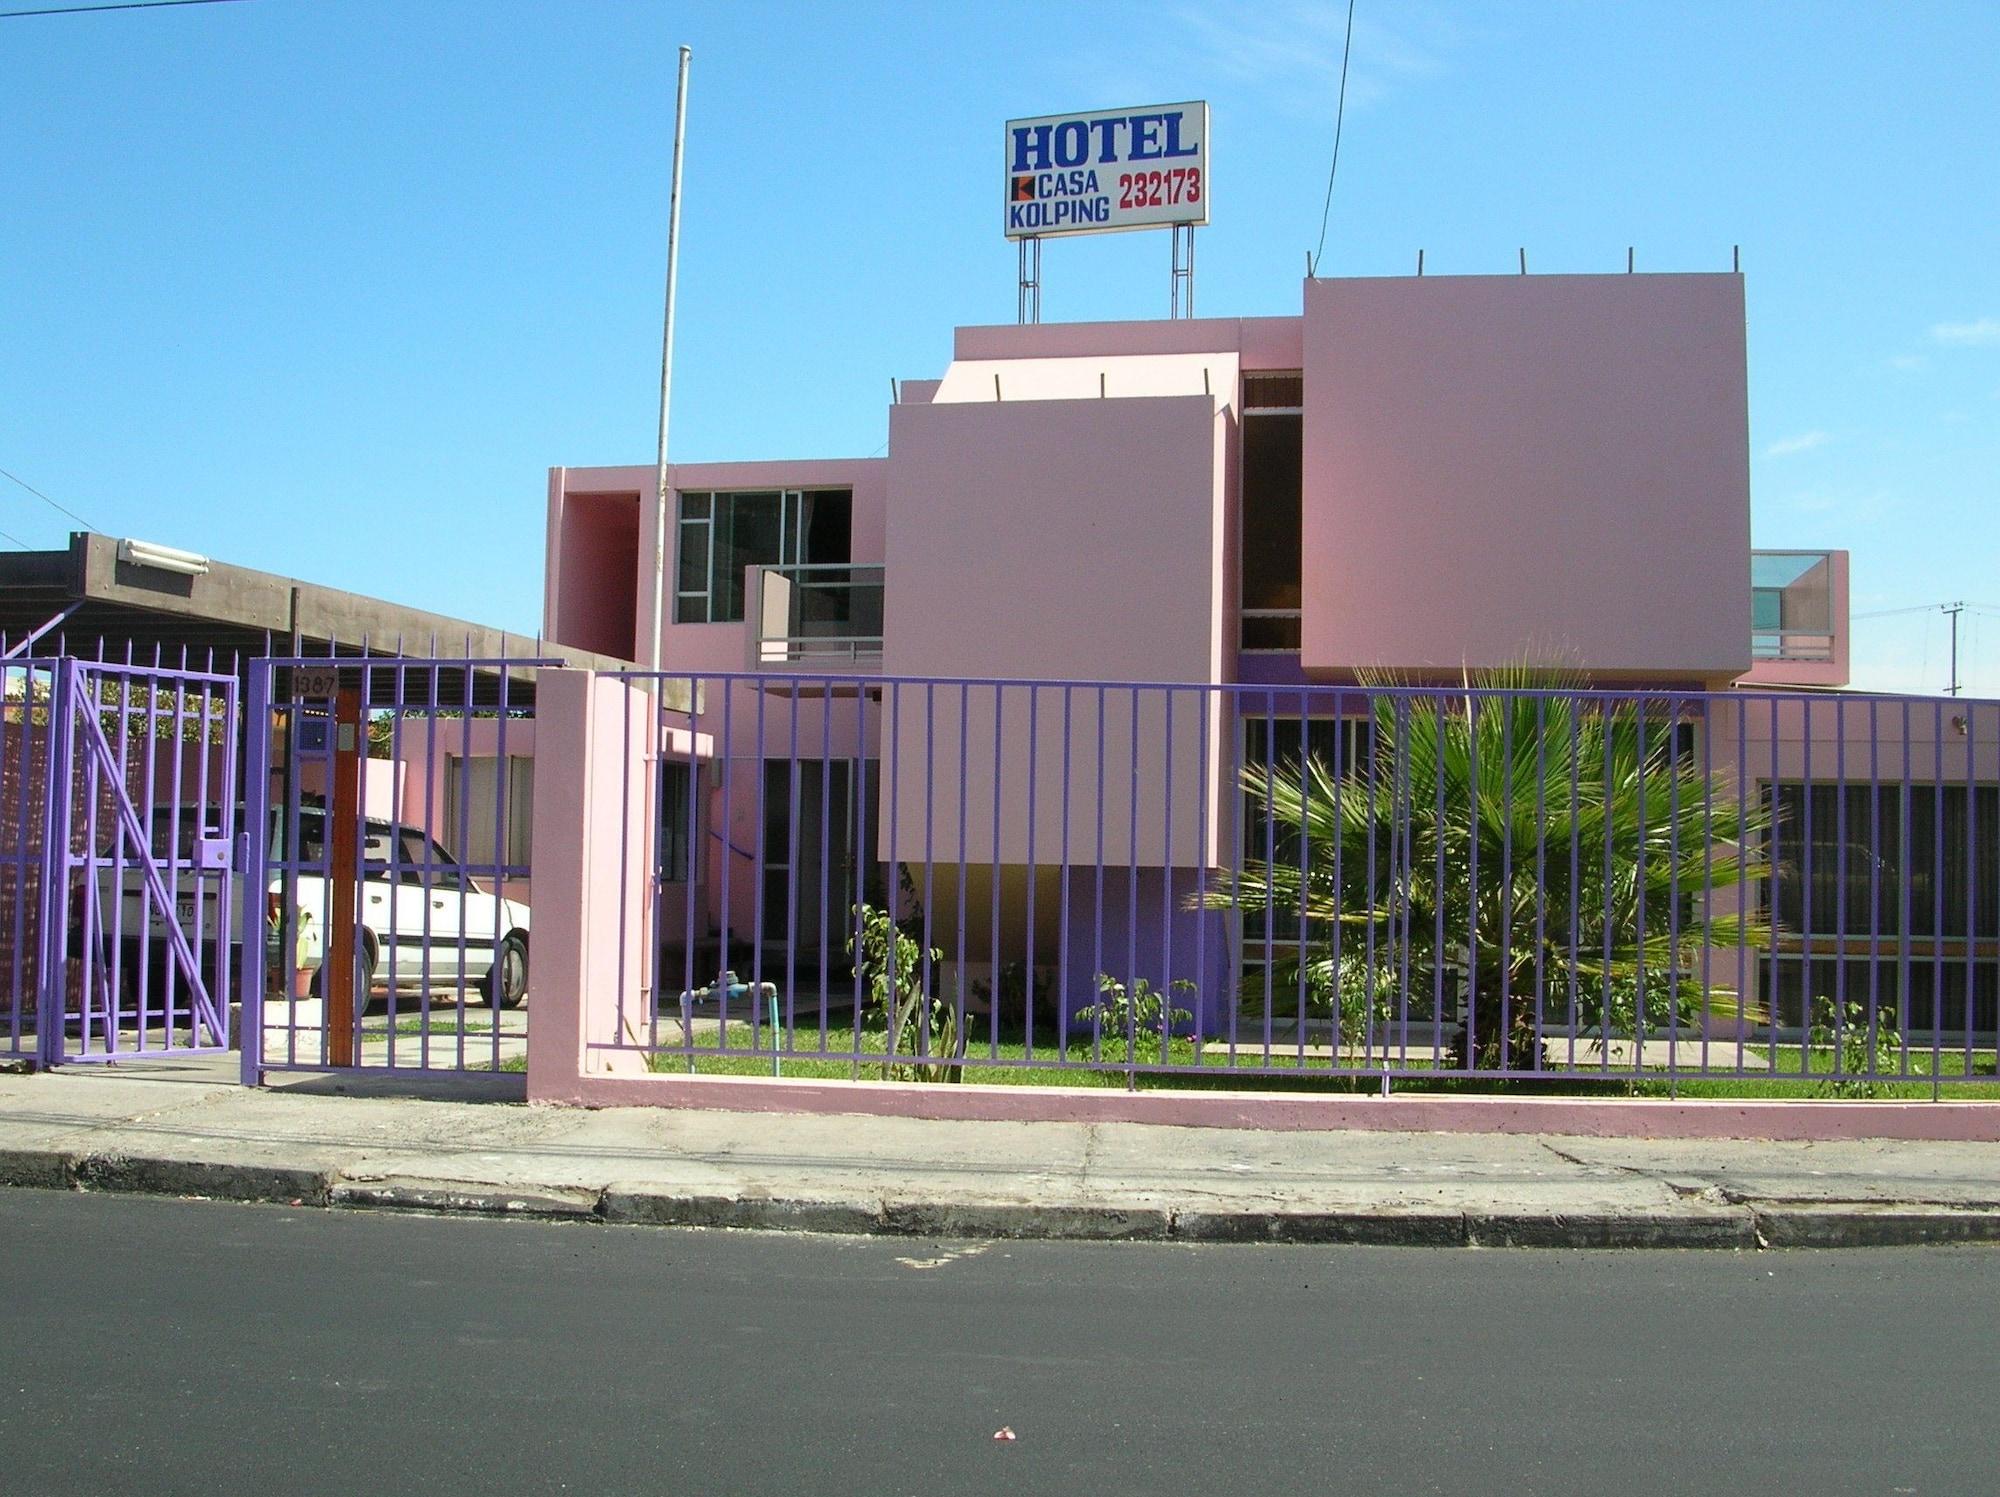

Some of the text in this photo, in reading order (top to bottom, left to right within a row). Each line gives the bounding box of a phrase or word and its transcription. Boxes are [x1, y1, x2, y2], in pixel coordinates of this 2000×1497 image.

[1012, 111, 1199, 172] HOTEL
[1038, 169, 1100, 199] CASA
[1119, 167, 1201, 209] 232173
[1010, 196, 1110, 229] KOLPING
[294, 676, 335, 694] 1387
